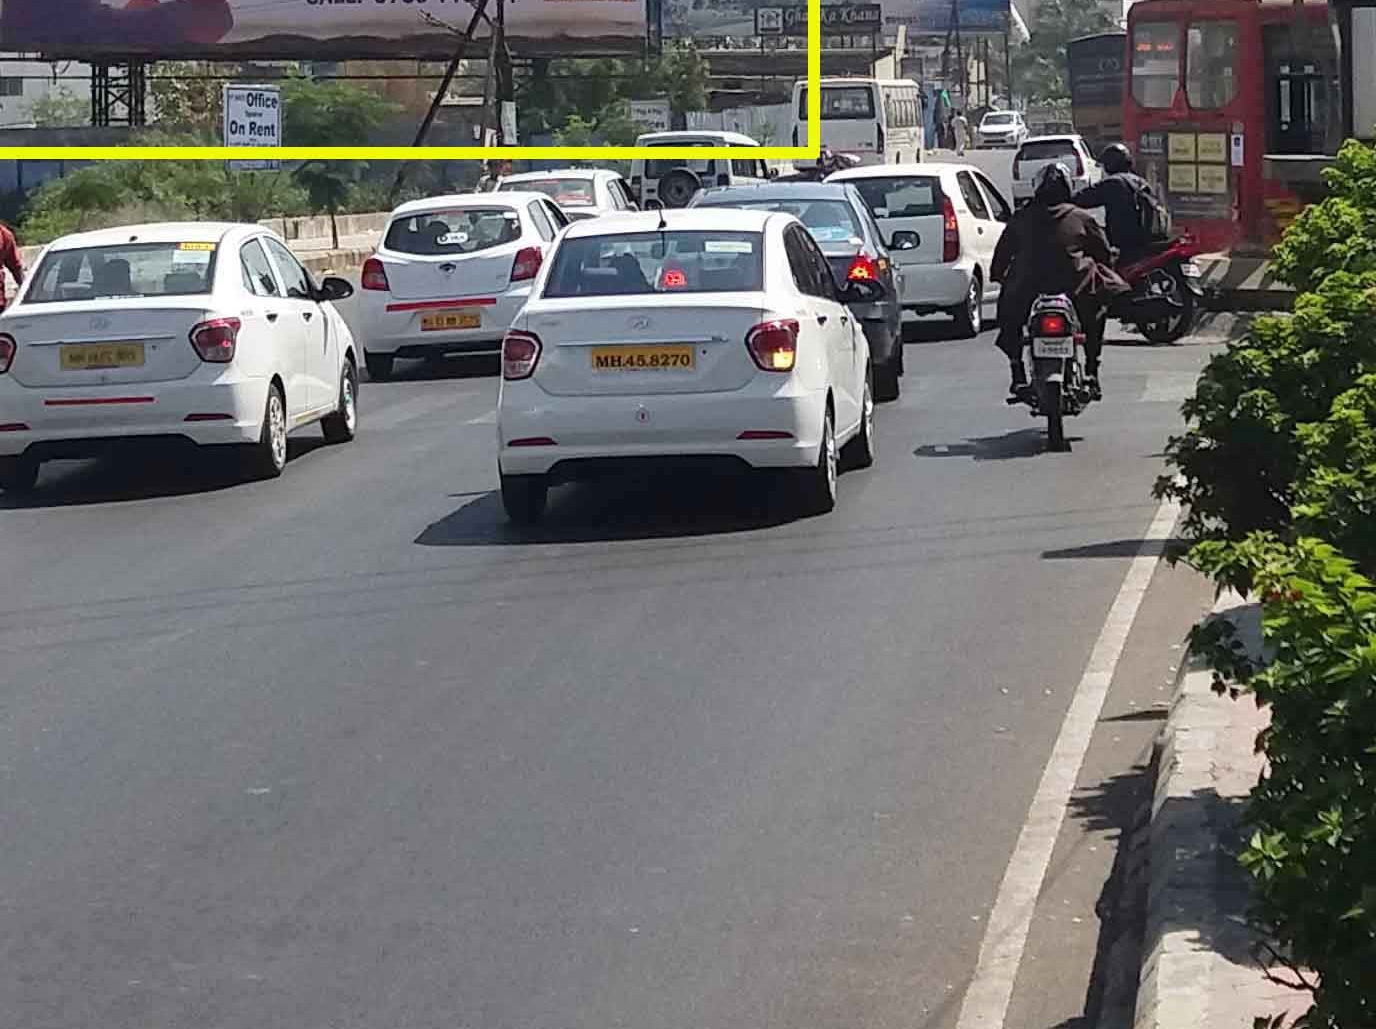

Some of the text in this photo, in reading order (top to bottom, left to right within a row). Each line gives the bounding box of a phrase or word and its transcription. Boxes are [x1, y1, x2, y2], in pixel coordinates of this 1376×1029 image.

[247, 92, 278, 109] Office
[230, 120, 276, 137] On Rent
[595, 354, 691, 368] MH.45.8270
